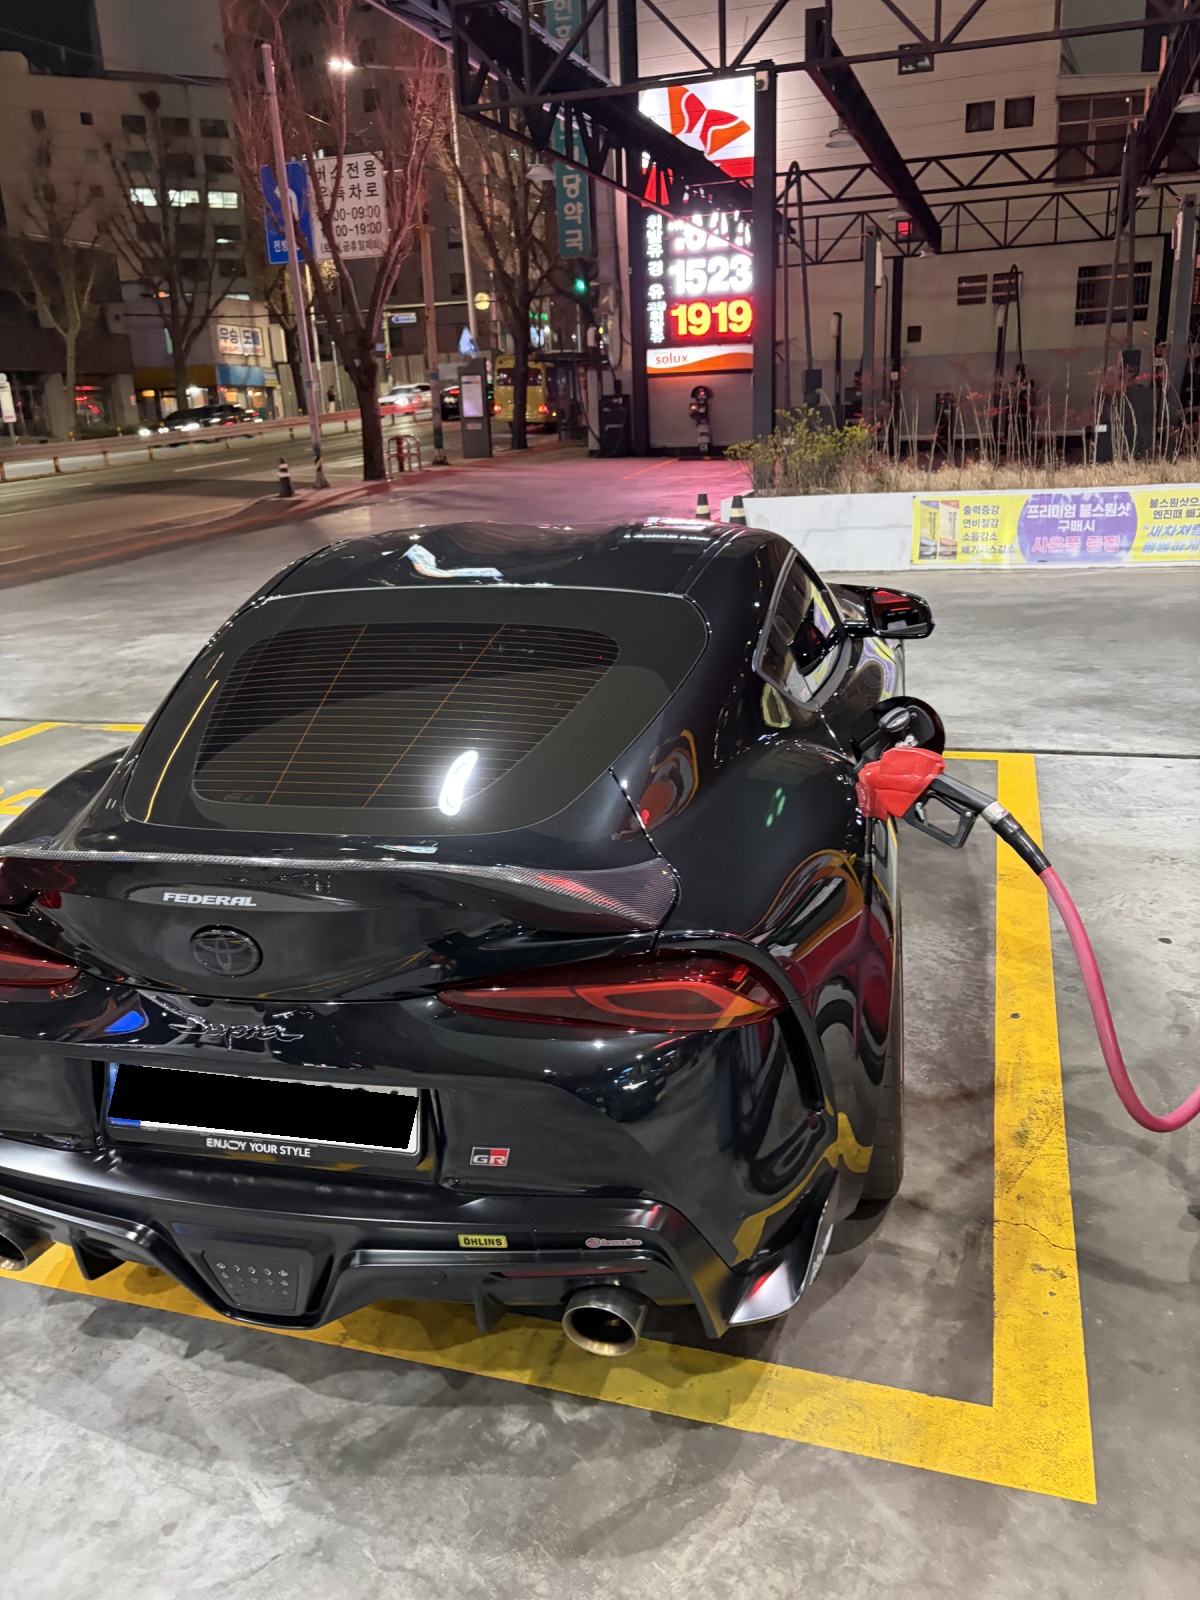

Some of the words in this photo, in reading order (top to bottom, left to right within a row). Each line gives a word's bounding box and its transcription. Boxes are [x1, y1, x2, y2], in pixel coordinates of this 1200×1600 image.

[646, 214, 664, 258] 휘발유
[668, 255, 753, 295] 1523
[671, 300, 753, 336] 1919
[655, 352, 688, 365] solux
[1149, 497, 1200, 508] 불스원샷으
[963, 505, 1000, 516] 출력증강
[1027, 504, 1076, 519] 프리미엄
[1079, 502, 1131, 518] 불스원샷
[962, 518, 999, 529] 연비절감
[1058, 519, 1096, 533] 구매시
[961, 531, 998, 541] 소음감소
[1031, 535, 1081, 553] 사은품
[1085, 534, 1120, 553] 증정
[162, 892, 257, 907] FEDERAL
[206, 1137, 247, 1151] ENJOY
[249, 1142, 278, 1154] YOUR
[279, 1146, 311, 1158] STYLE
[463, 1236, 503, 1246] ÖHLINS
